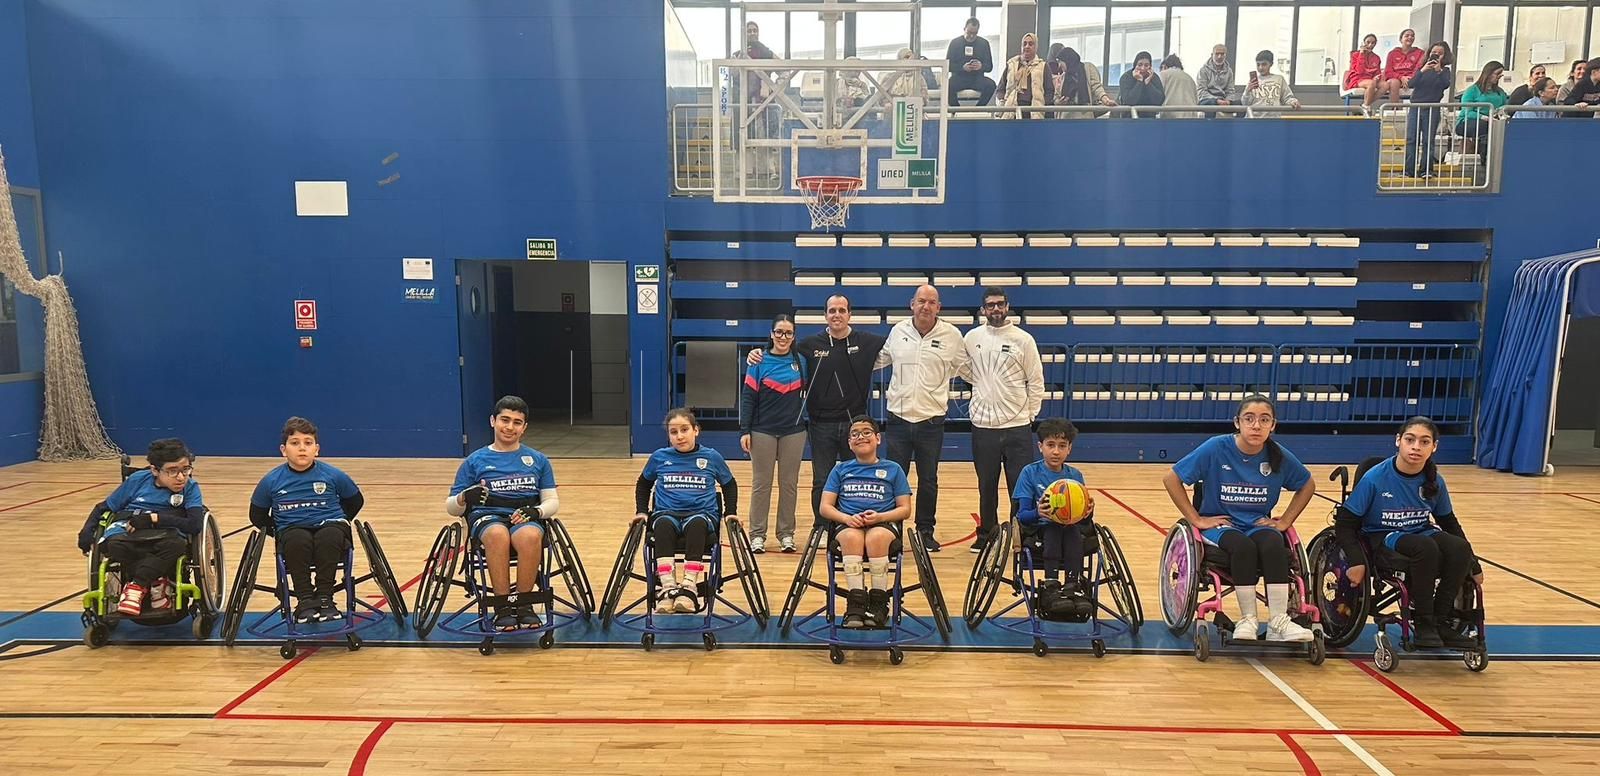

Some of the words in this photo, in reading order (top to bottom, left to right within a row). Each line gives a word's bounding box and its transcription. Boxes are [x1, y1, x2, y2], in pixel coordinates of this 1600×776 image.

[905, 103, 915, 142] MELILLA
[881, 169, 904, 178] UNED
[404, 287, 435, 297] MELILLA
[490, 477, 536, 488] MELILLA
[663, 475, 706, 484] MELILLA
[843, 484, 885, 494] MELILLA
[1220, 485, 1268, 495] MELILLA
[1220, 494, 1267, 502] BALONCESTO
[1381, 510, 1430, 520] MELILLA
